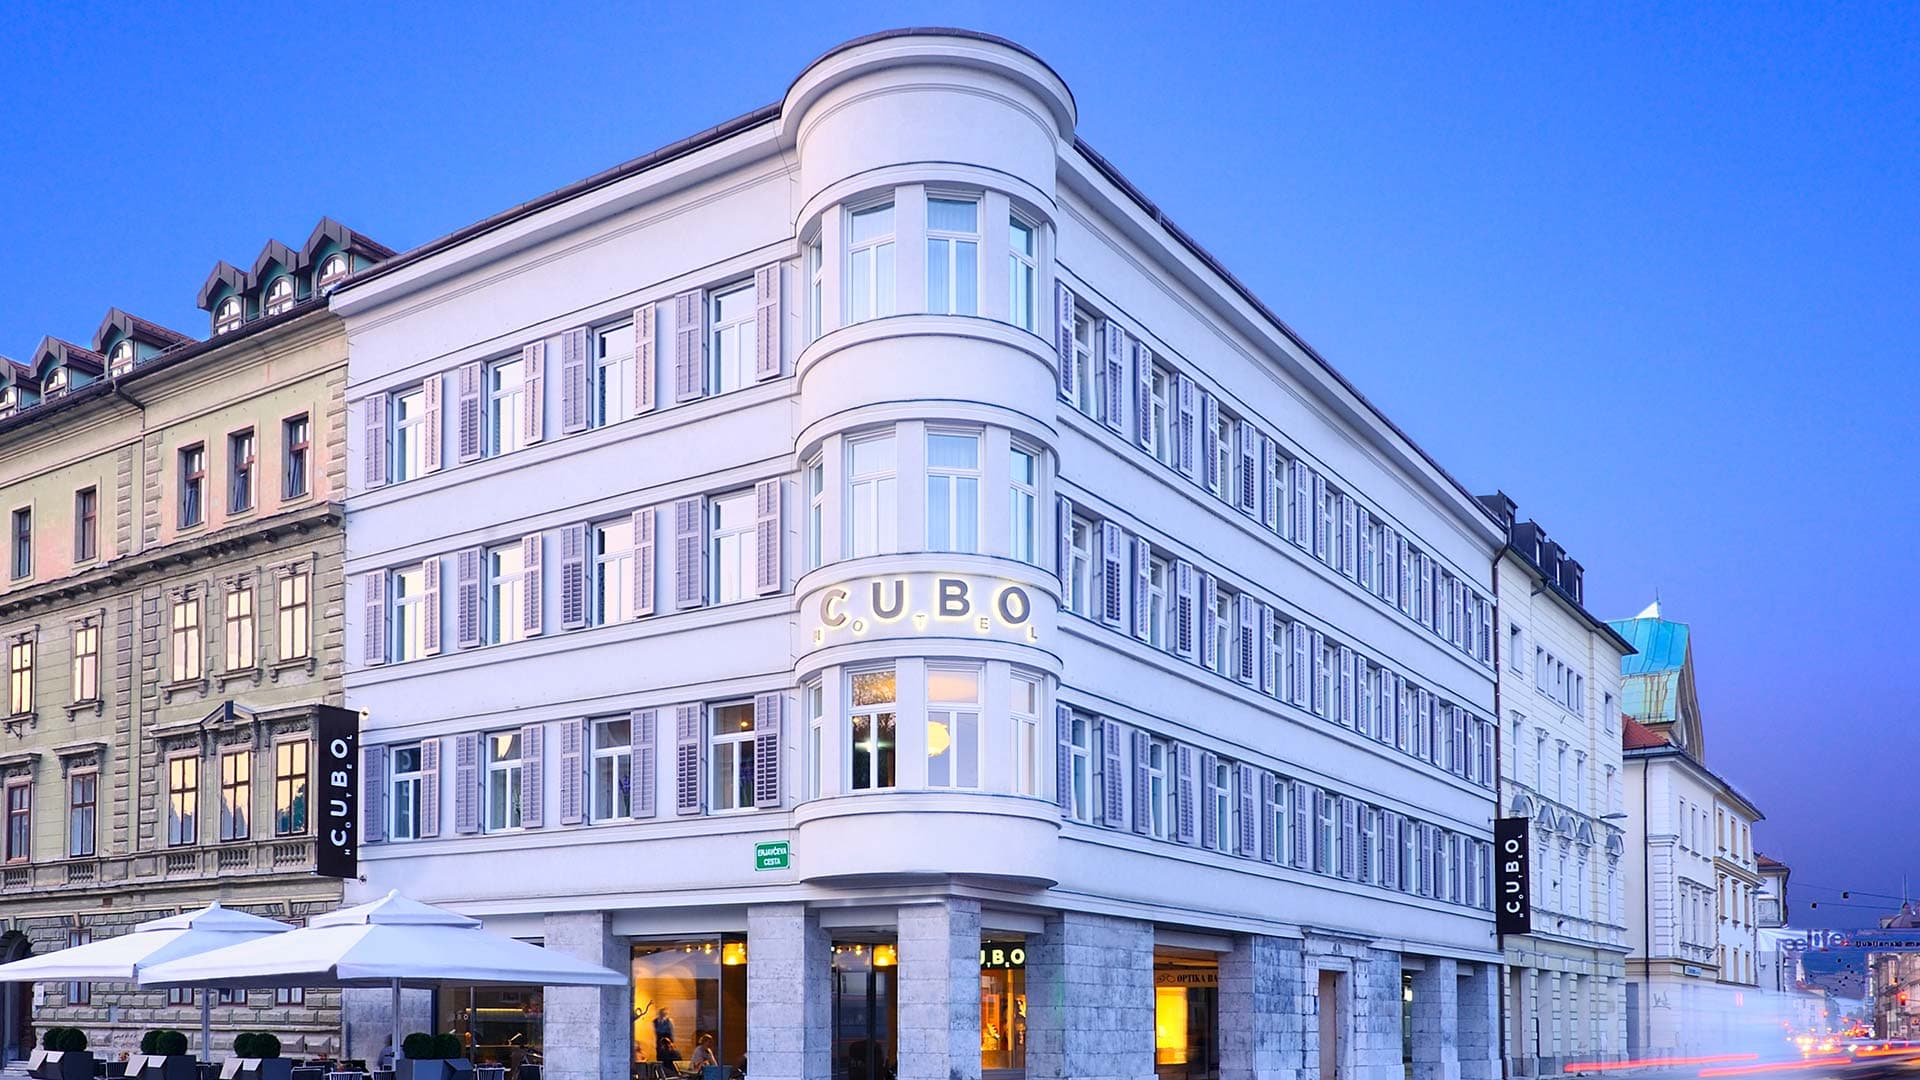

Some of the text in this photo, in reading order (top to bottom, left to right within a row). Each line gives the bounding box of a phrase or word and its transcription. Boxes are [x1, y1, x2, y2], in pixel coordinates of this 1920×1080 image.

[819, 578, 1031, 627] CUBO
[330, 738, 348, 847] CUBO
[344, 734, 353, 856] HOTEL
[1504, 839, 1521, 913] CUBO
[1176, 973, 1206, 983] OPTIKA
